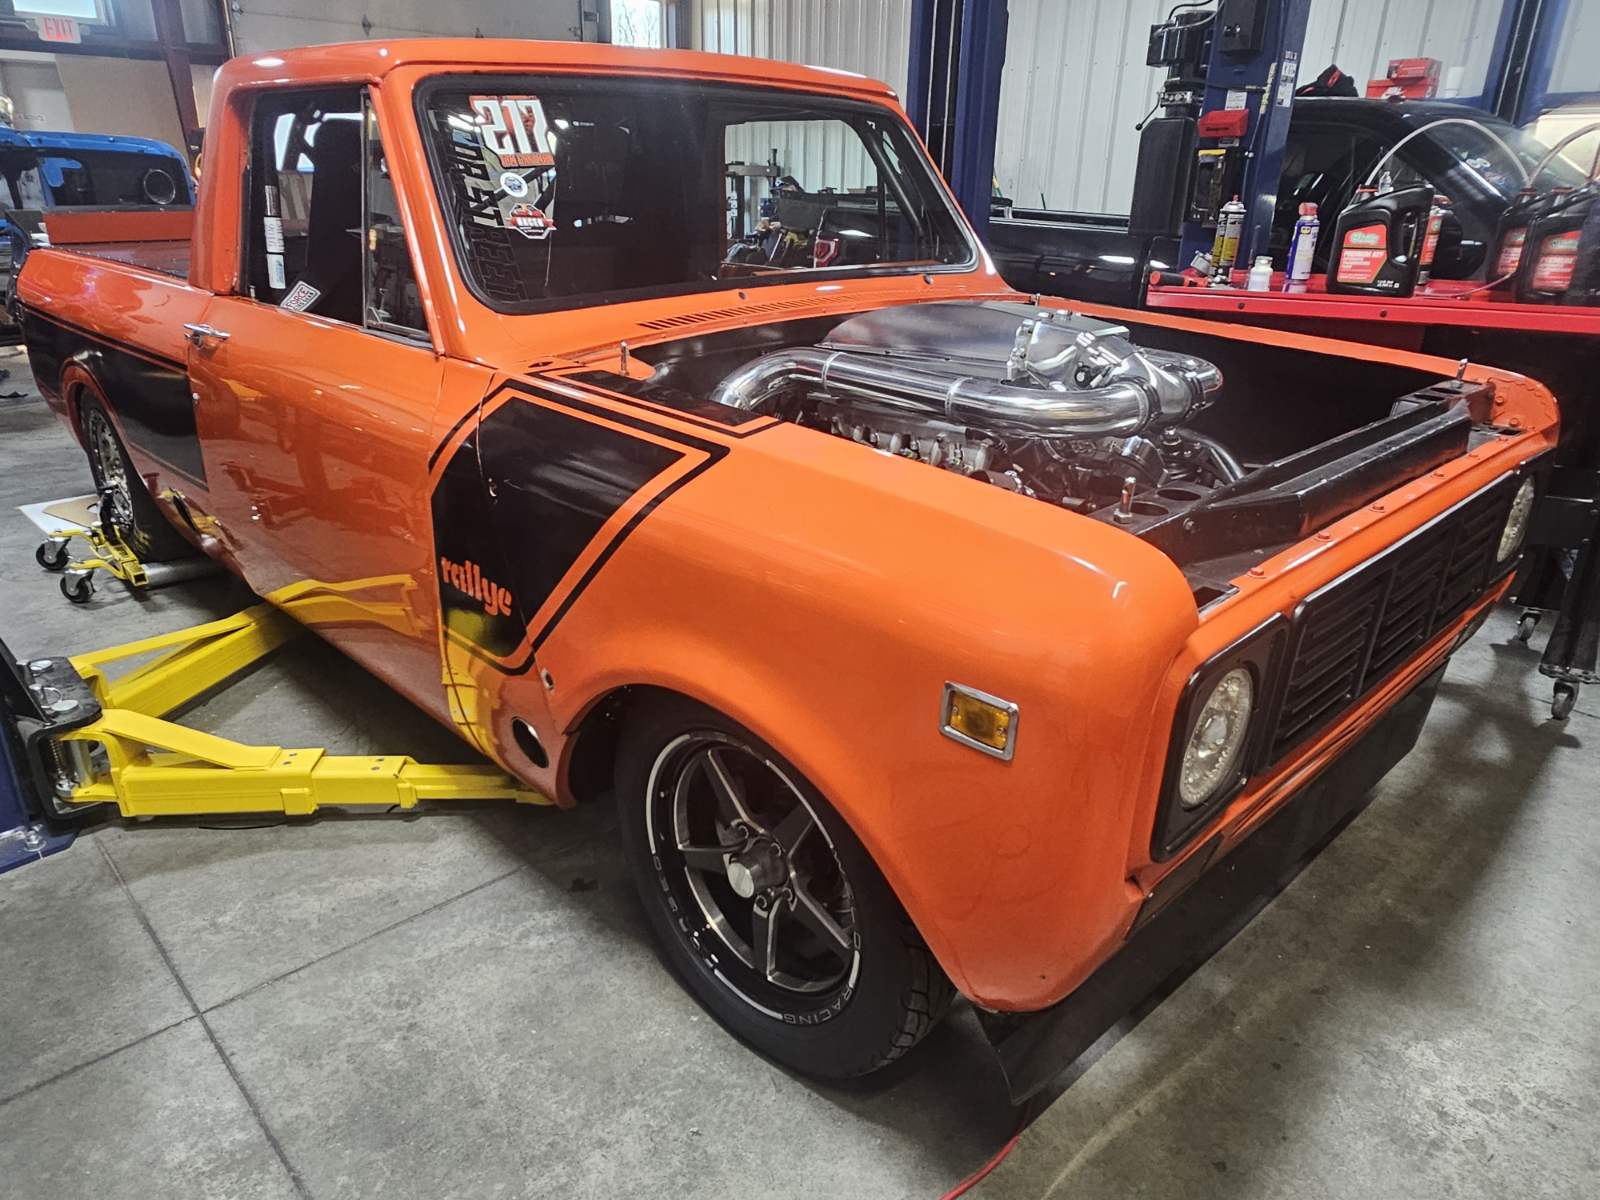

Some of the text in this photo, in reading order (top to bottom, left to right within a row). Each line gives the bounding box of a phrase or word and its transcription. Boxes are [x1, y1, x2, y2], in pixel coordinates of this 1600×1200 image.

[43, 15, 73, 40] EXIT
[472, 98, 551, 155] 217
[441, 556, 512, 616] rallye
[783, 984, 852, 1024] RACING
